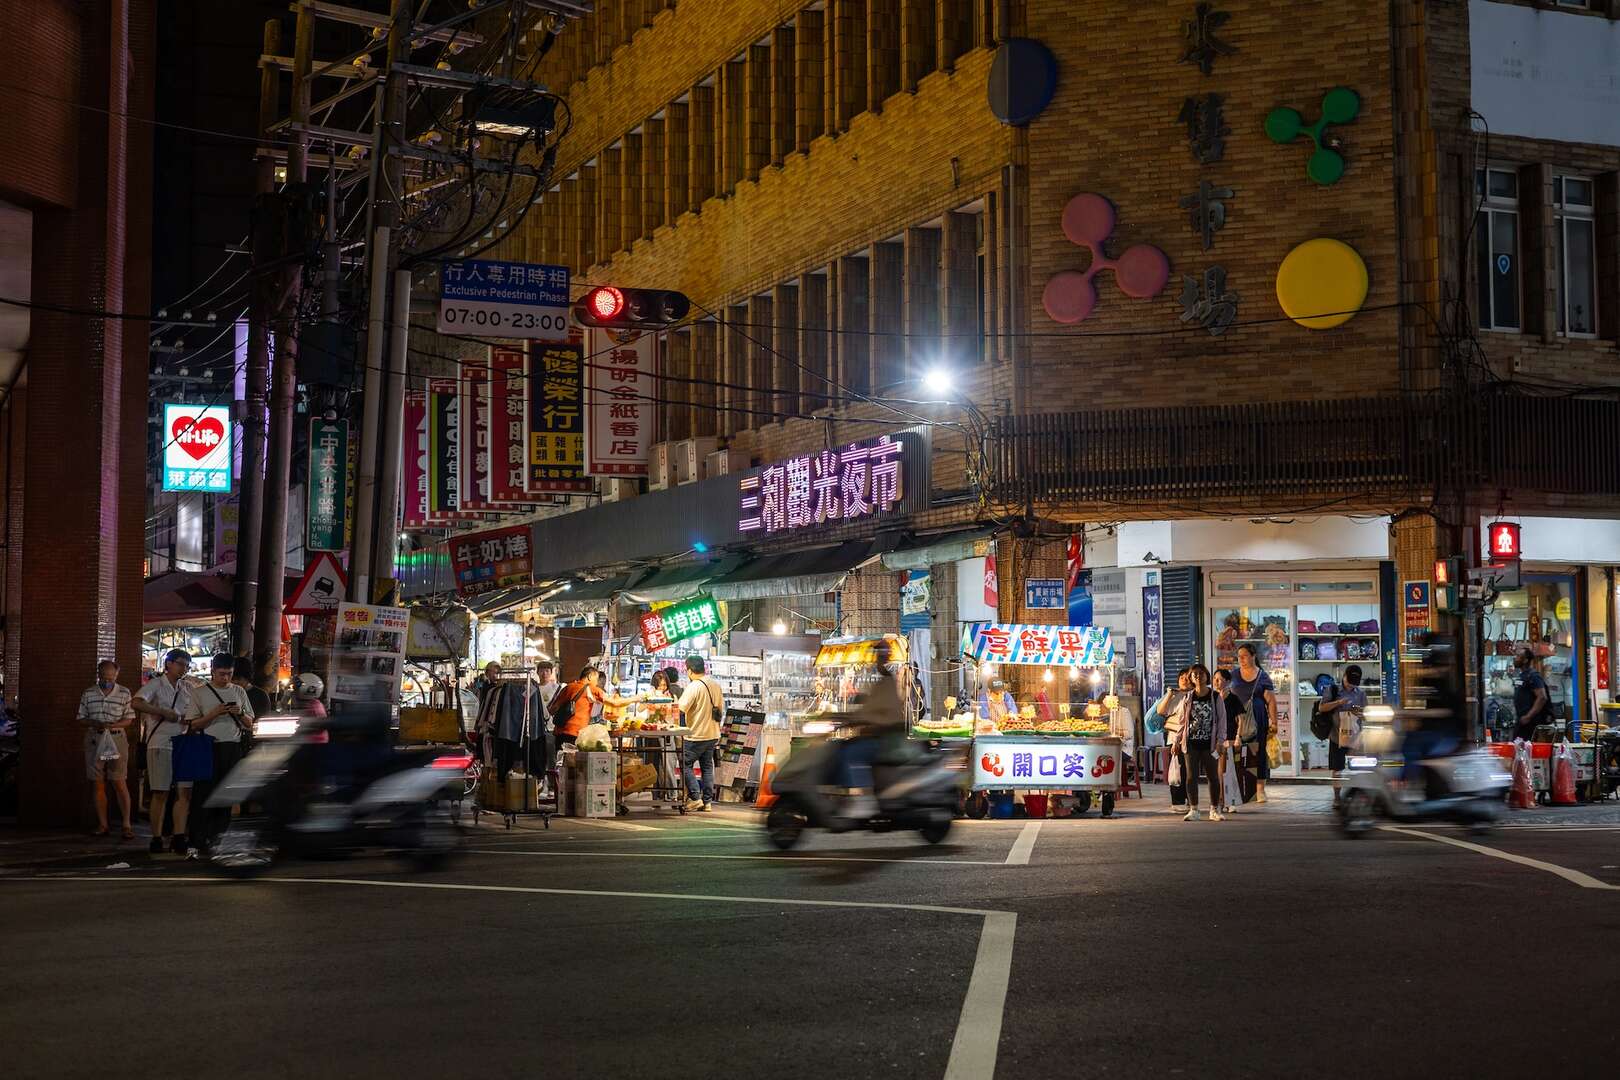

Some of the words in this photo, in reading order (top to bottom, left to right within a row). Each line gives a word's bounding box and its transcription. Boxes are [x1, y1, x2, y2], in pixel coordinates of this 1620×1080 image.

[444, 263, 567, 289] 行人專用時相
[444, 284, 487, 297] Exclusive
[490, 288, 536, 301] Pedestrian
[539, 292, 566, 304] Phase
[444, 308, 566, 332] 07:00-23:00
[318, 434, 339, 516] 中央北路
[739, 435, 903, 532] 三和觀光夜市
[456, 534, 529, 567] 牛奶棒
[662, 602, 717, 641] 甘草芭樂
[1012, 752, 1086, 778] 開口笑
